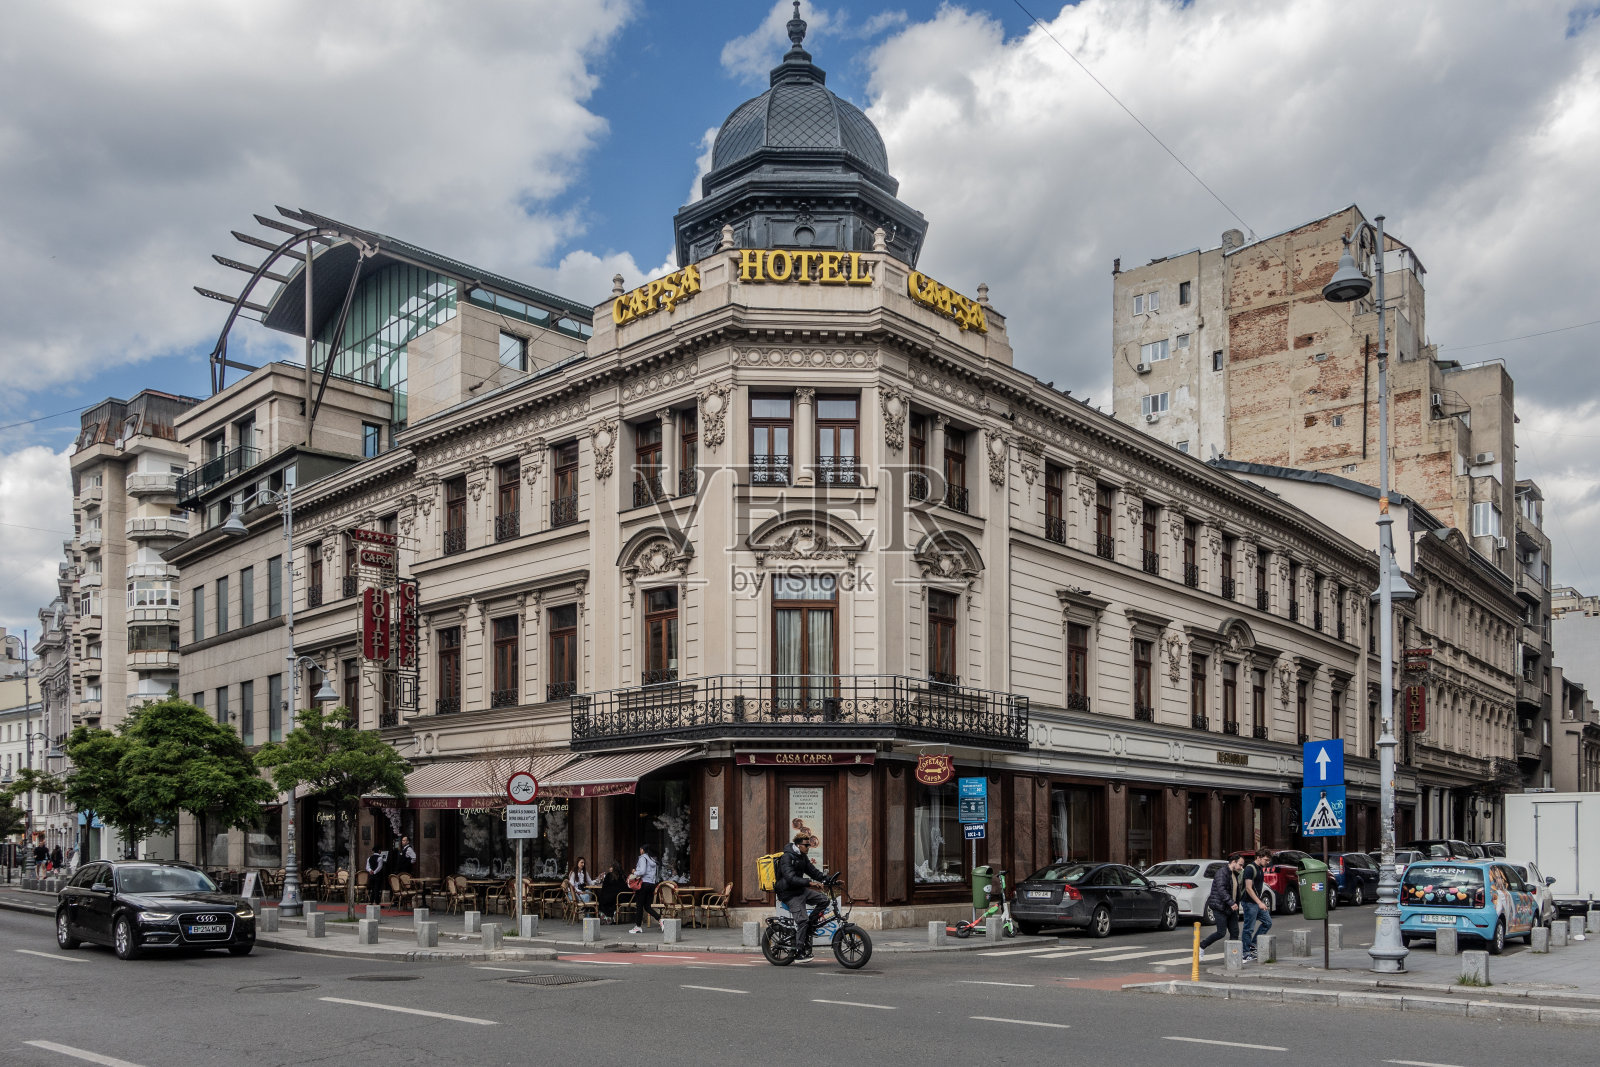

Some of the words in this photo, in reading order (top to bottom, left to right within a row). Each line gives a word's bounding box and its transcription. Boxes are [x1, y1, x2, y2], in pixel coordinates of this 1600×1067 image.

[739, 249, 873, 286] HOTEL
[371, 587, 385, 662] HOTEL
[1410, 686, 1420, 732] HOTEL
[775, 754, 801, 763] CASA
[802, 754, 833, 763] CAPSA
